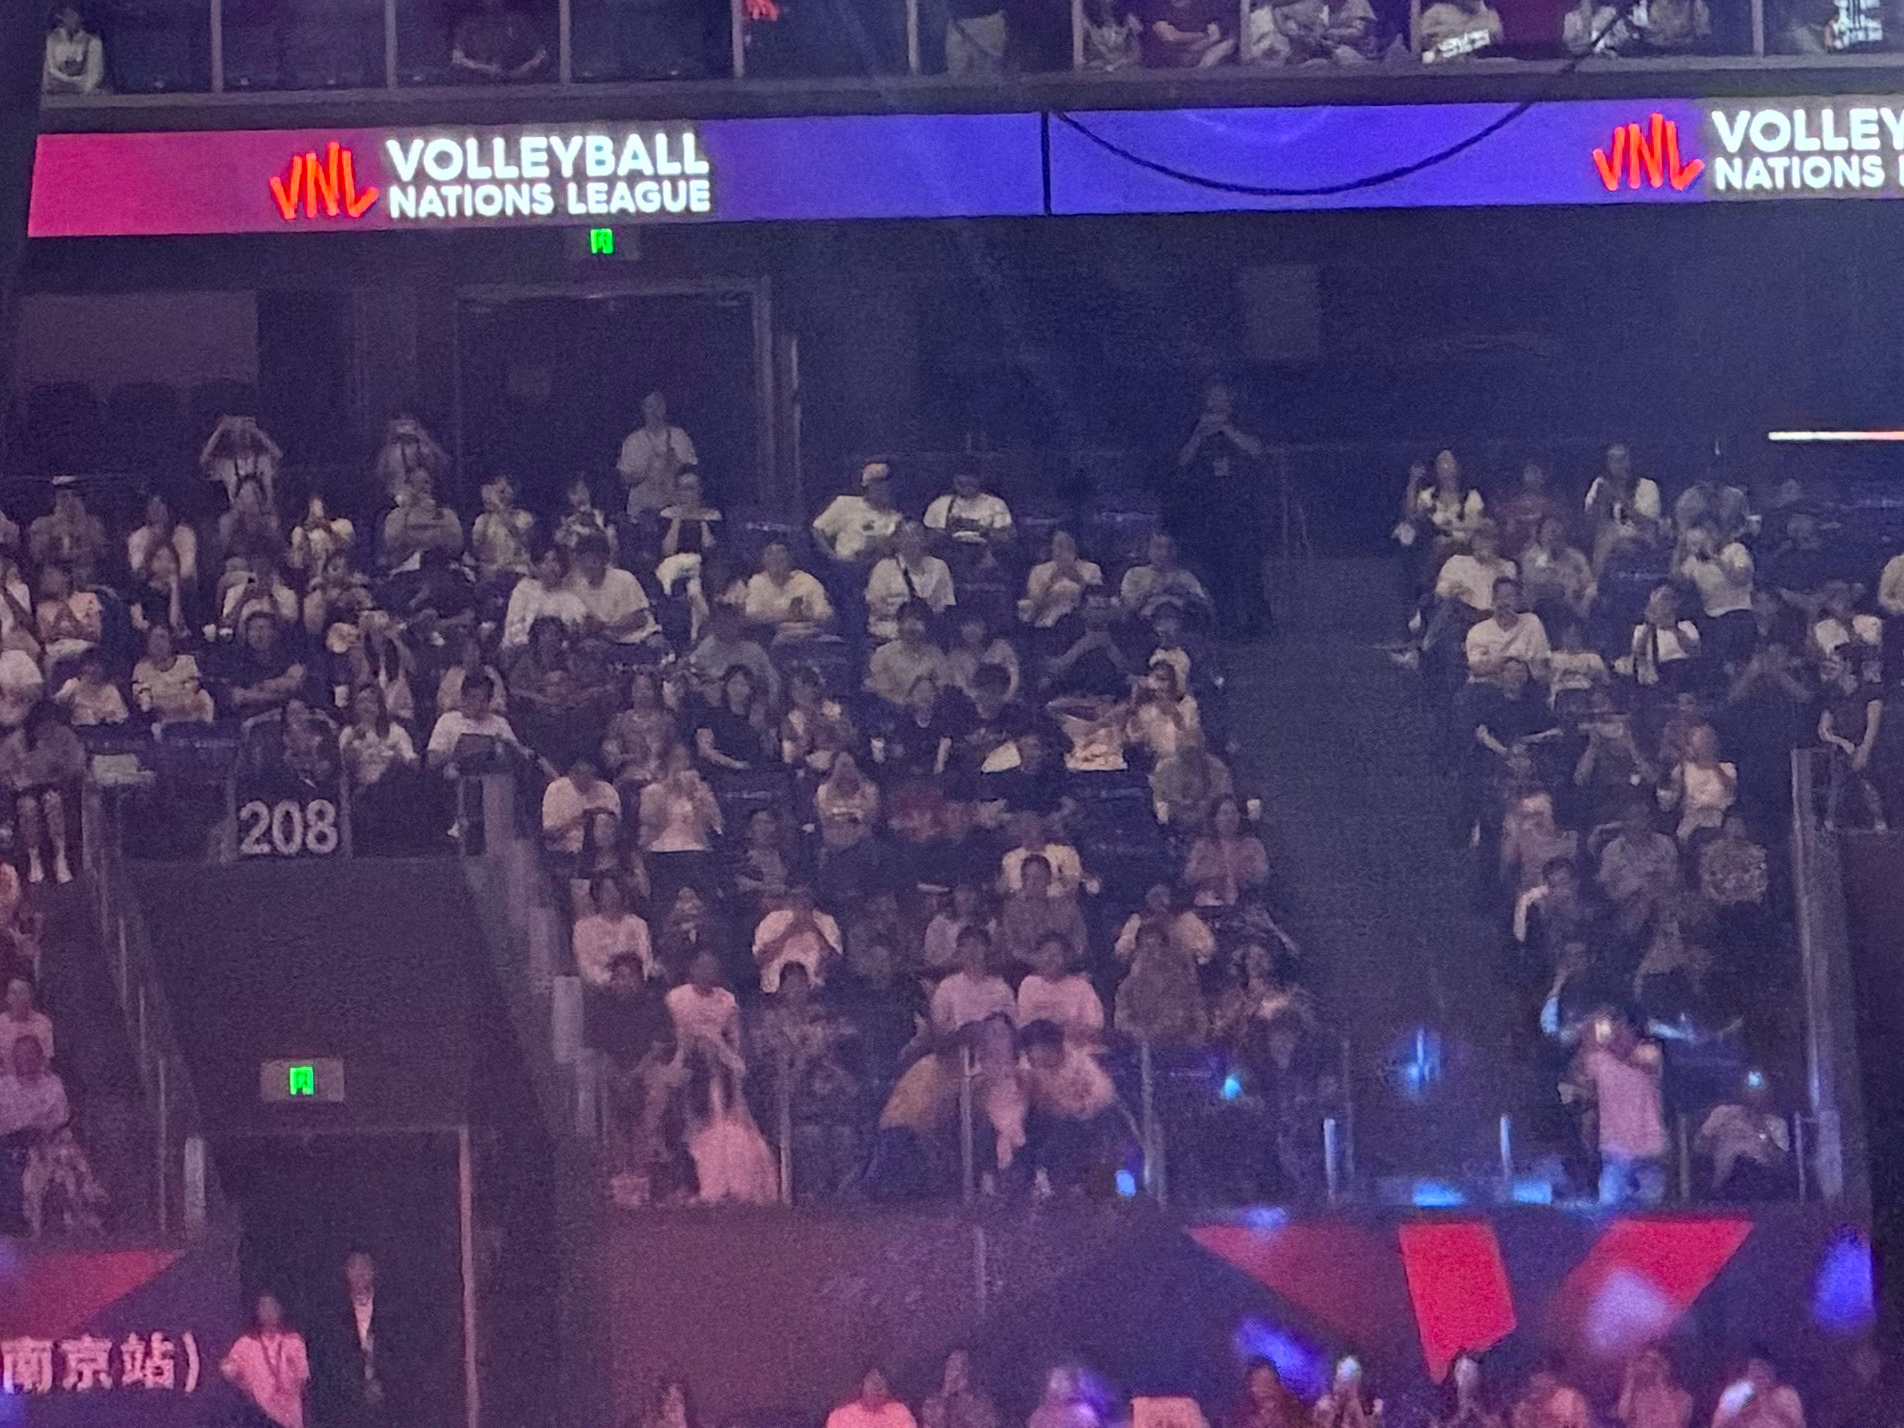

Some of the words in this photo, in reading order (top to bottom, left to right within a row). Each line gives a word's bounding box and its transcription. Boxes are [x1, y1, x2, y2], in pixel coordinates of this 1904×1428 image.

[386, 133, 710, 181] VOLLEYBALL
[1715, 155, 1886, 190] NATIONS
[390, 185, 554, 218] NATIONS
[568, 180, 711, 214] LEAGUE
[240, 799, 338, 855] 208
